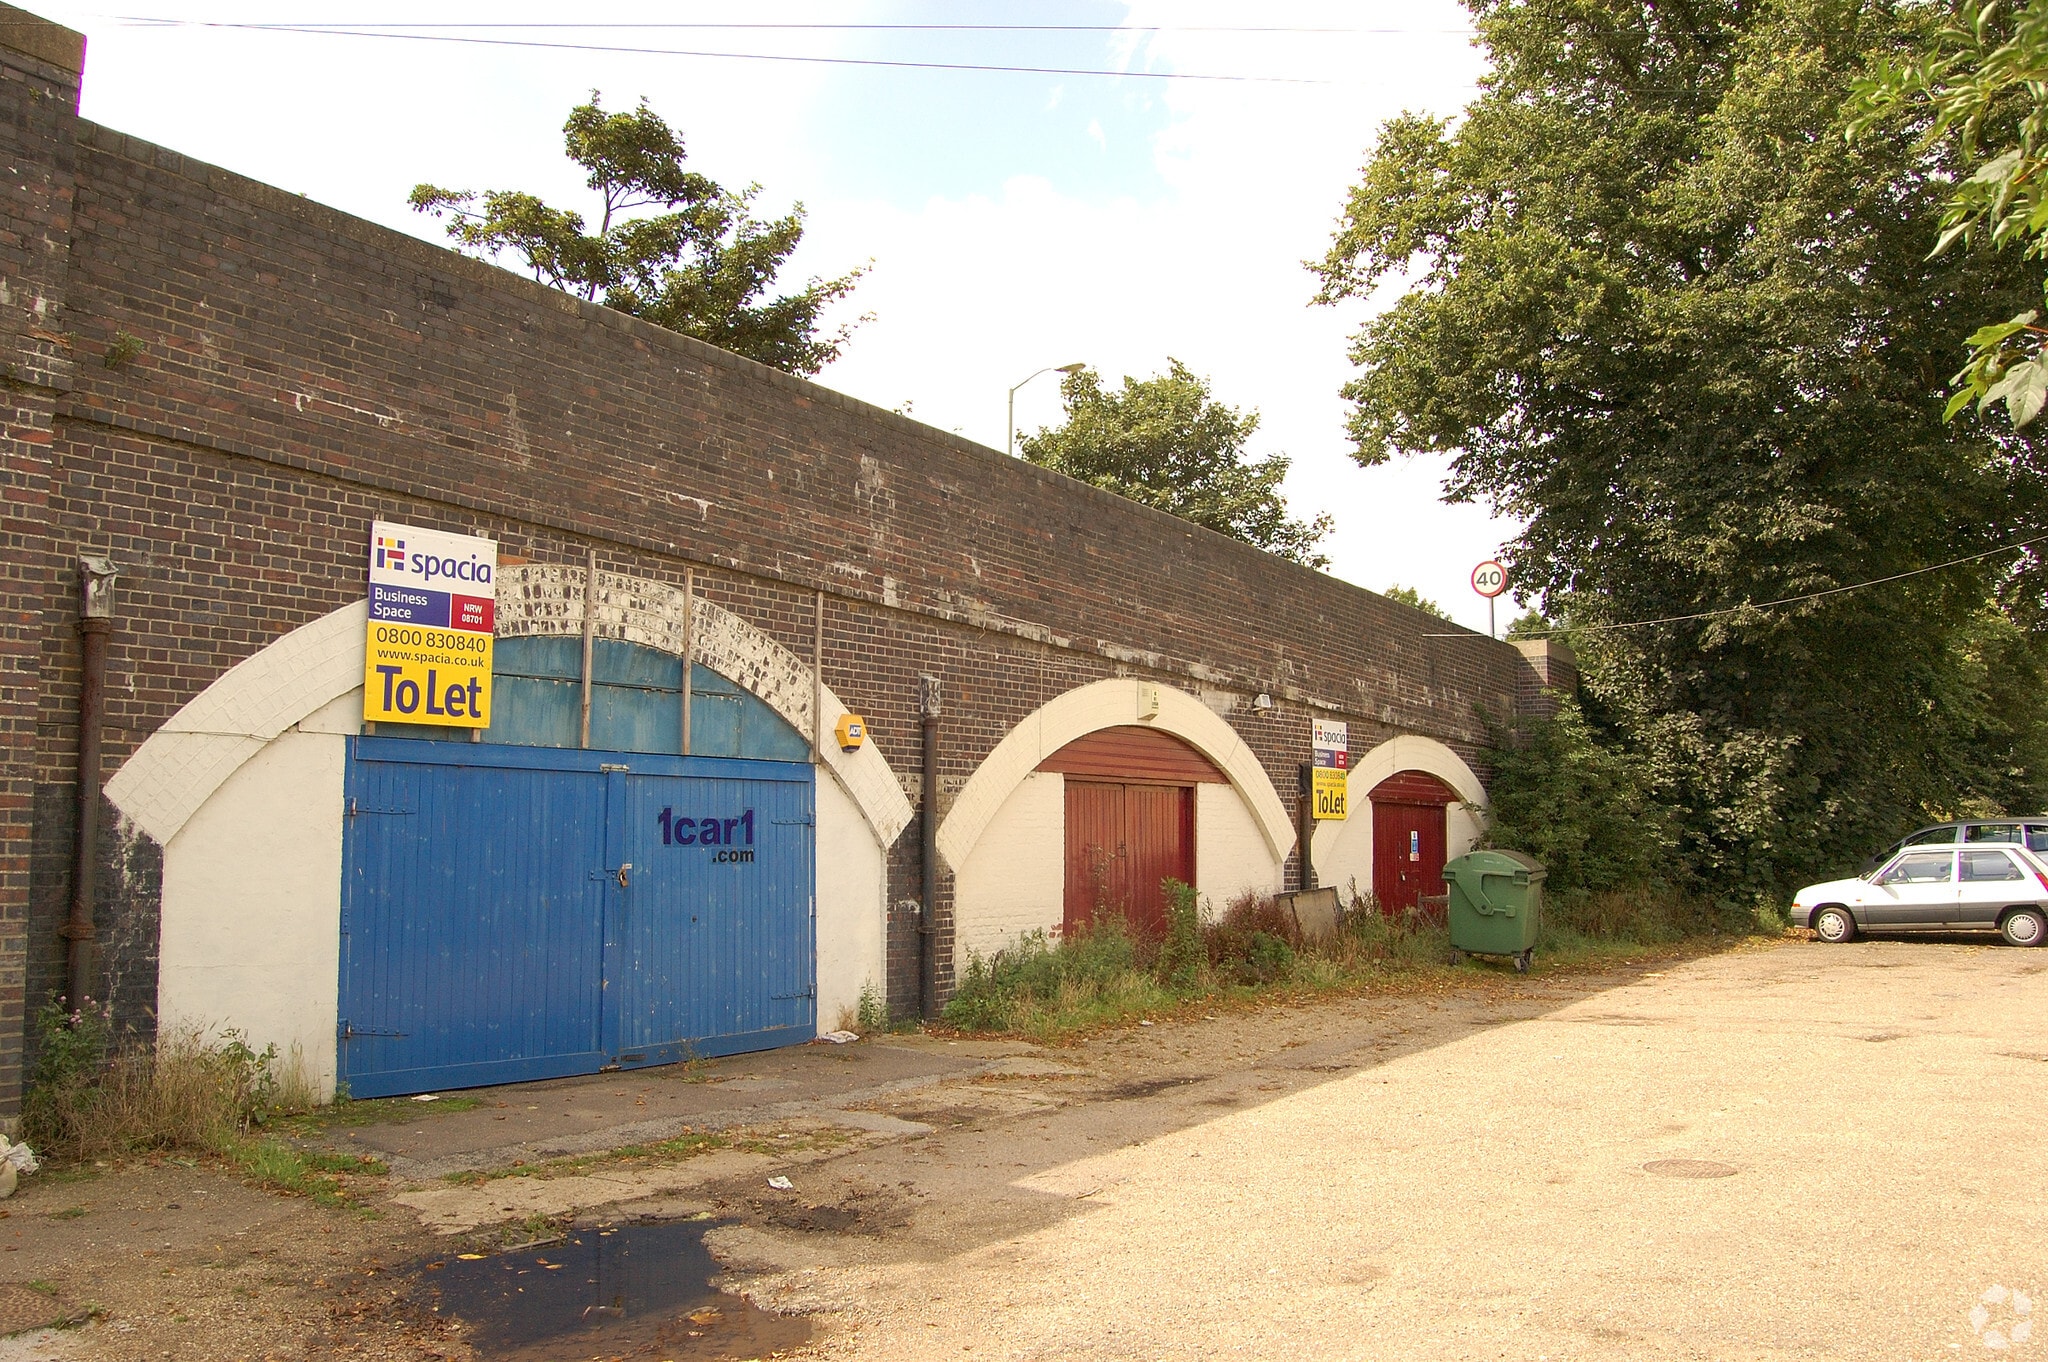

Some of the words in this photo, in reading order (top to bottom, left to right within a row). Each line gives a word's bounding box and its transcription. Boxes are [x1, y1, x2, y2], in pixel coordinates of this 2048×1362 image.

[411, 553, 491, 584] spacia
[1476, 571, 1501, 586] 40
[374, 587, 428, 606] Business
[373, 603, 412, 619] Space
[463, 603, 483, 614] NRW
[461, 614, 483, 625] 08701
[376, 627, 422, 646] 0800
[426, 632, 486, 653] 830840
[377, 649, 485, 668] www.spacia.co.uk
[376, 664, 420, 714] To
[426, 669, 482, 719] Let
[1323, 729, 1346, 746] spacia
[1316, 789, 1329, 814] To
[1330, 790, 1345, 815] Let
[658, 807, 753, 845] 1car1
[712, 850, 755, 863] .com
